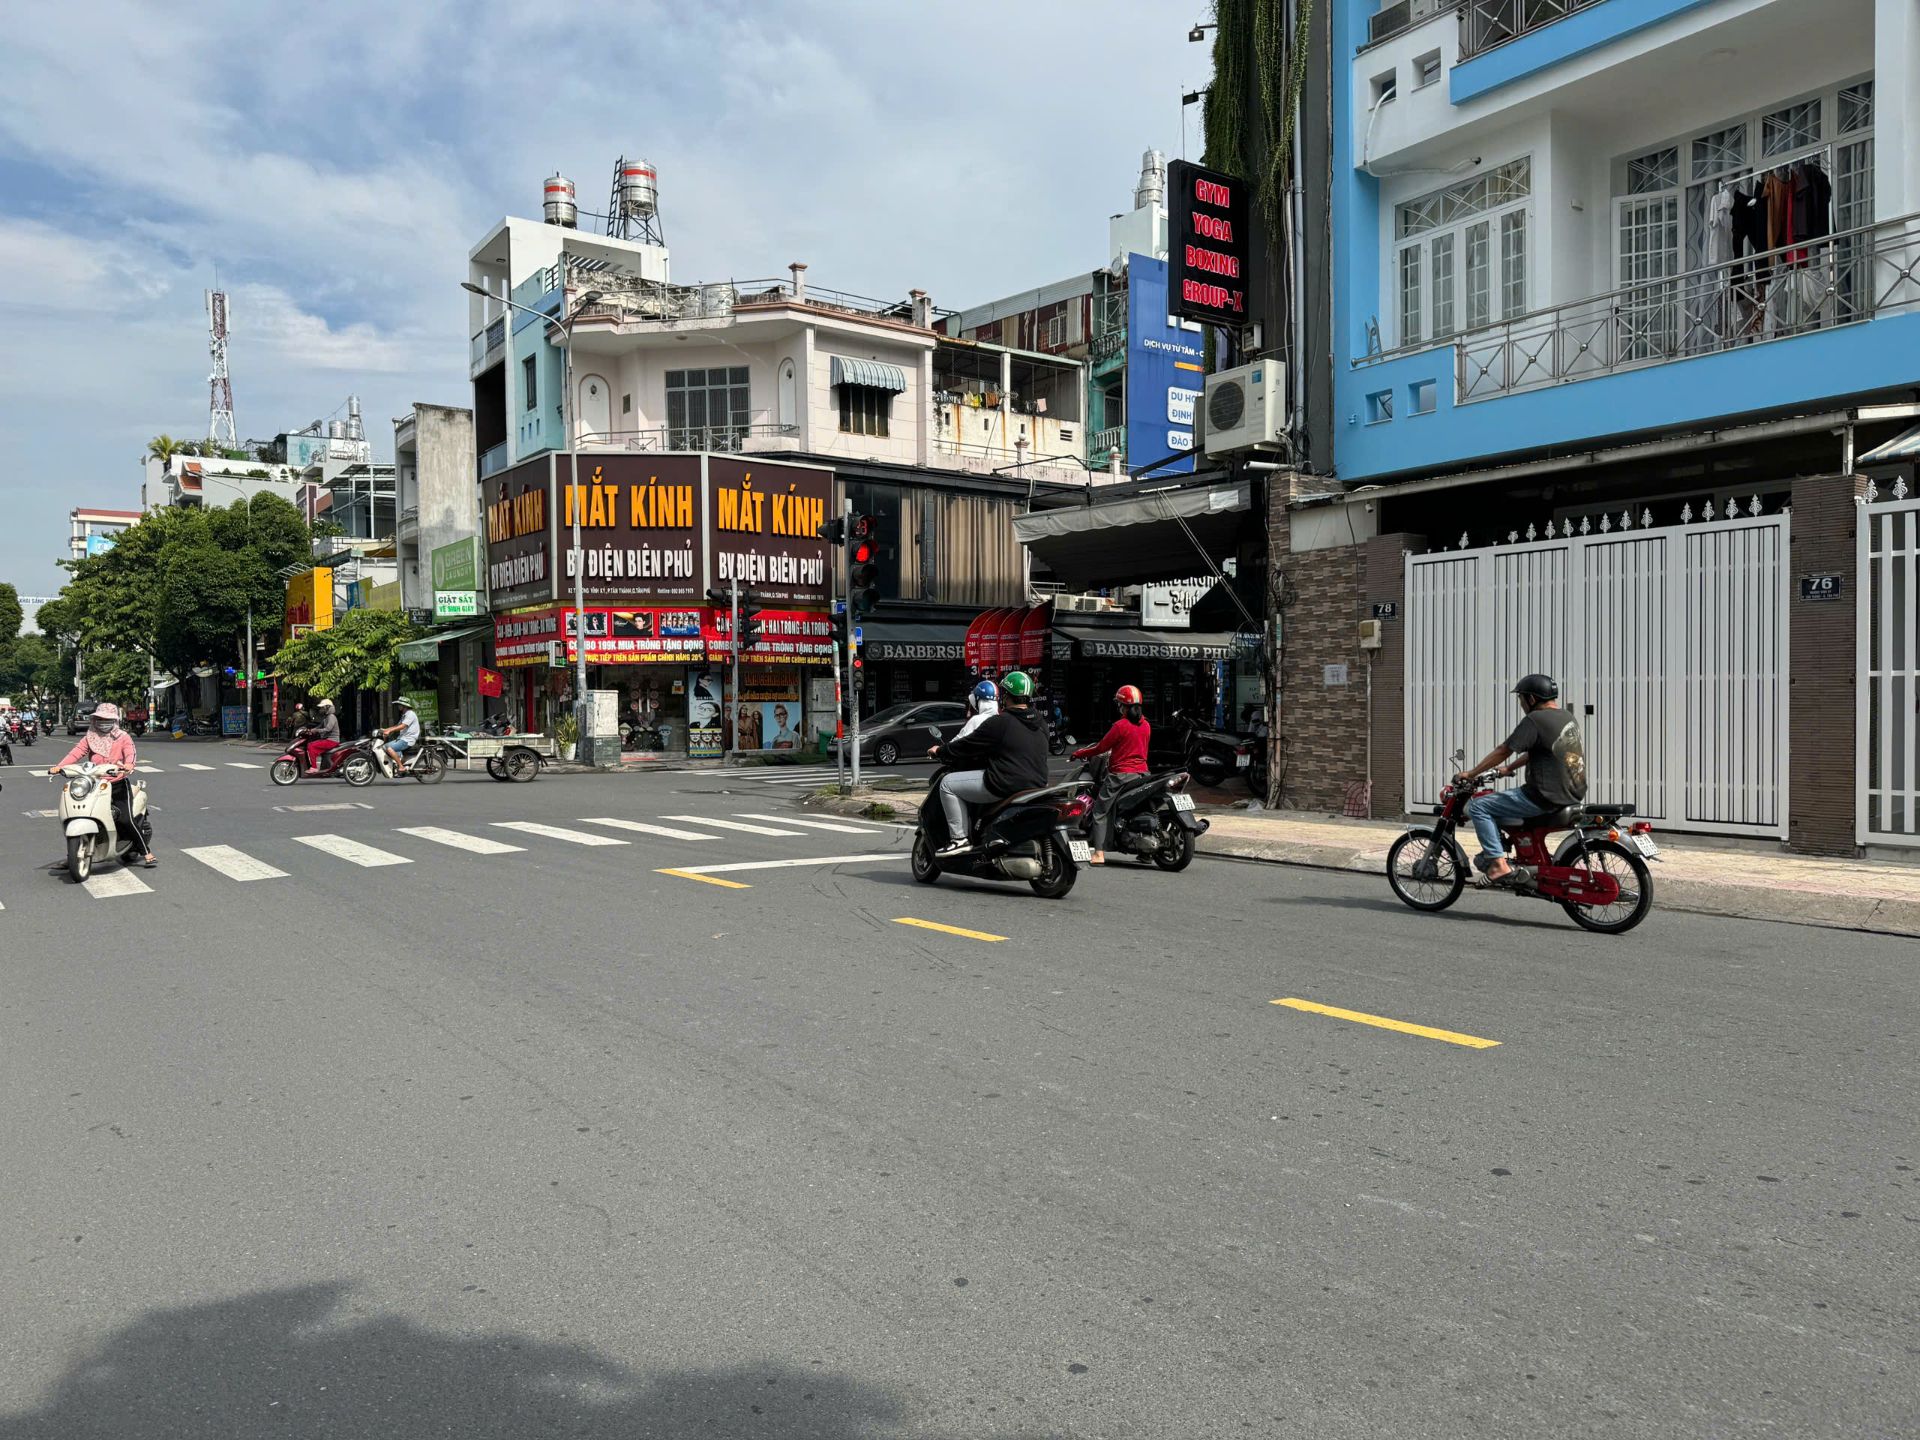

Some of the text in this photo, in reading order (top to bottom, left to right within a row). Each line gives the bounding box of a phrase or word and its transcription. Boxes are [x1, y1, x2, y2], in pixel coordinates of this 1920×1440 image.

[1196, 178, 1230, 208] GYM
[1192, 212, 1233, 242] YOGA
[1185, 245, 1240, 278] BOXING
[1182, 279, 1244, 312] GROUP-X
[1144, 339, 1161, 349] DỊCH
[1171, 391, 1183, 401] DU
[565, 466, 693, 528] MẮT KÍNH
[718, 472, 824, 538] MẮT KÍNH
[445, 546, 472, 567] GREEN
[588, 542, 623, 581] ĐIỆN
[627, 542, 661, 577] BIÊN
[664, 539, 693, 577] PHỦ
[719, 548, 824, 586] BV ĐIỆN BIÊN PHỦ
[1809, 577, 1833, 590] 76
[1377, 603, 1392, 613] 78
[883, 645, 966, 659] BARBERSH
[1095, 643, 1199, 659] BARBERSHOP
